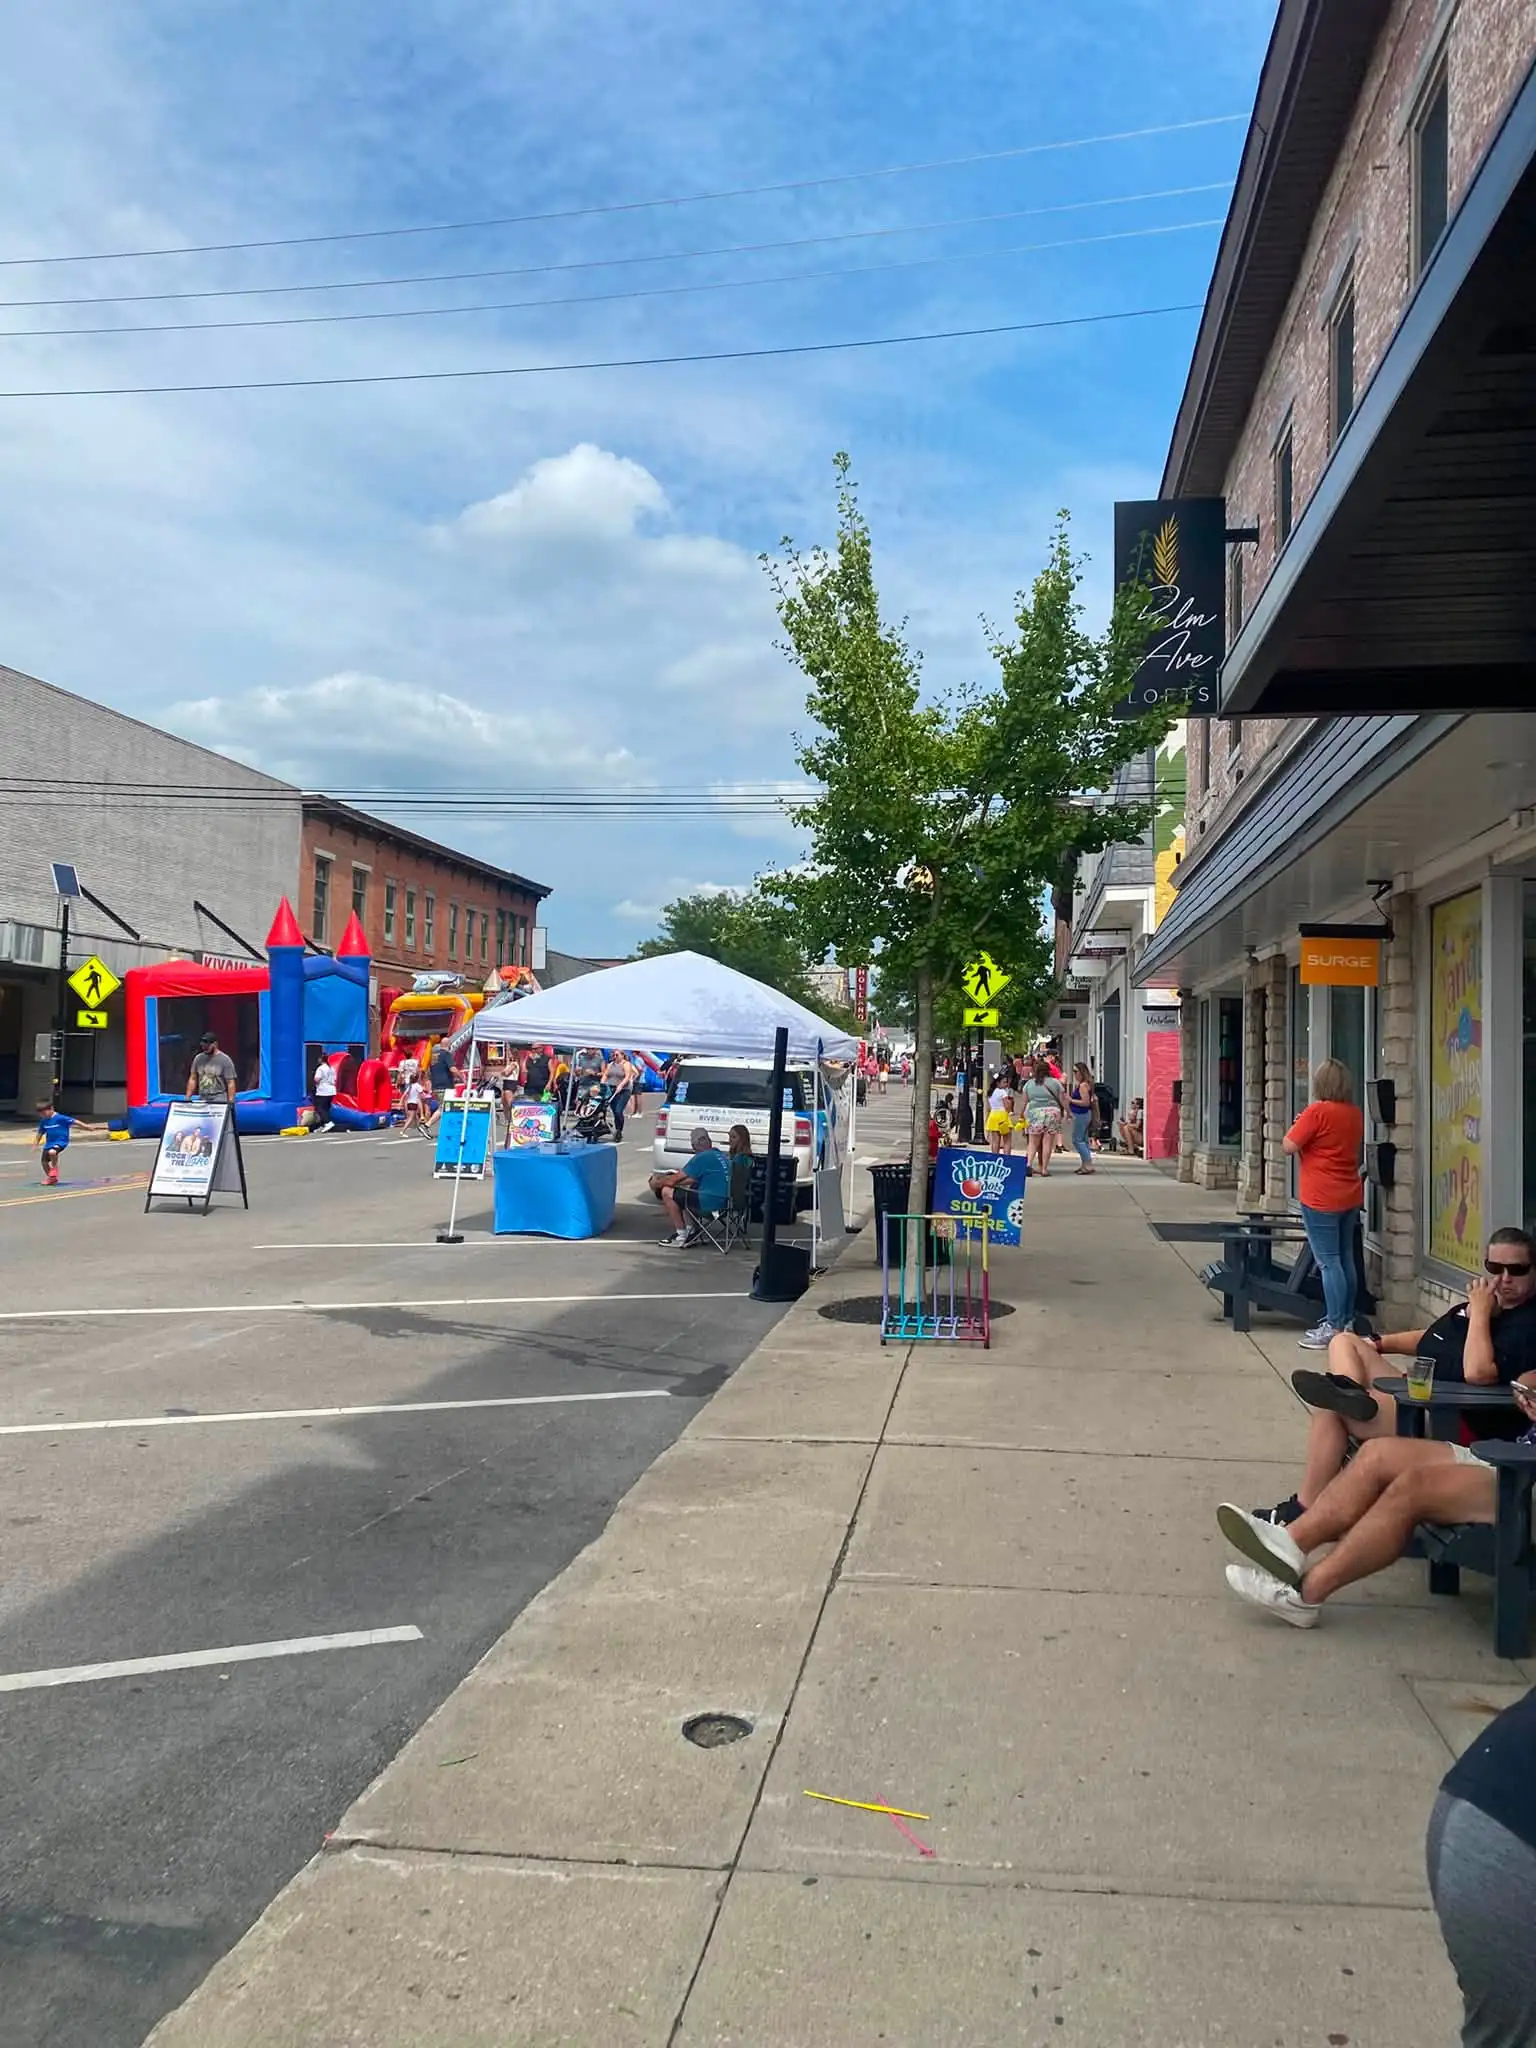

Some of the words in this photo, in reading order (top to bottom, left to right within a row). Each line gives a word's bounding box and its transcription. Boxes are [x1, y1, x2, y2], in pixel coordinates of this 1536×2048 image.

[1137, 584, 1217, 629] Plm
[1127, 630, 1214, 681] Ave
[1128, 686, 1210, 704] LOFTS
[1307, 954, 1373, 968] SURGE
[857, 969, 865, 1020] HOLLAND
[950, 1199, 993, 1215] SOLD
[962, 1218, 1009, 1232] HERE
